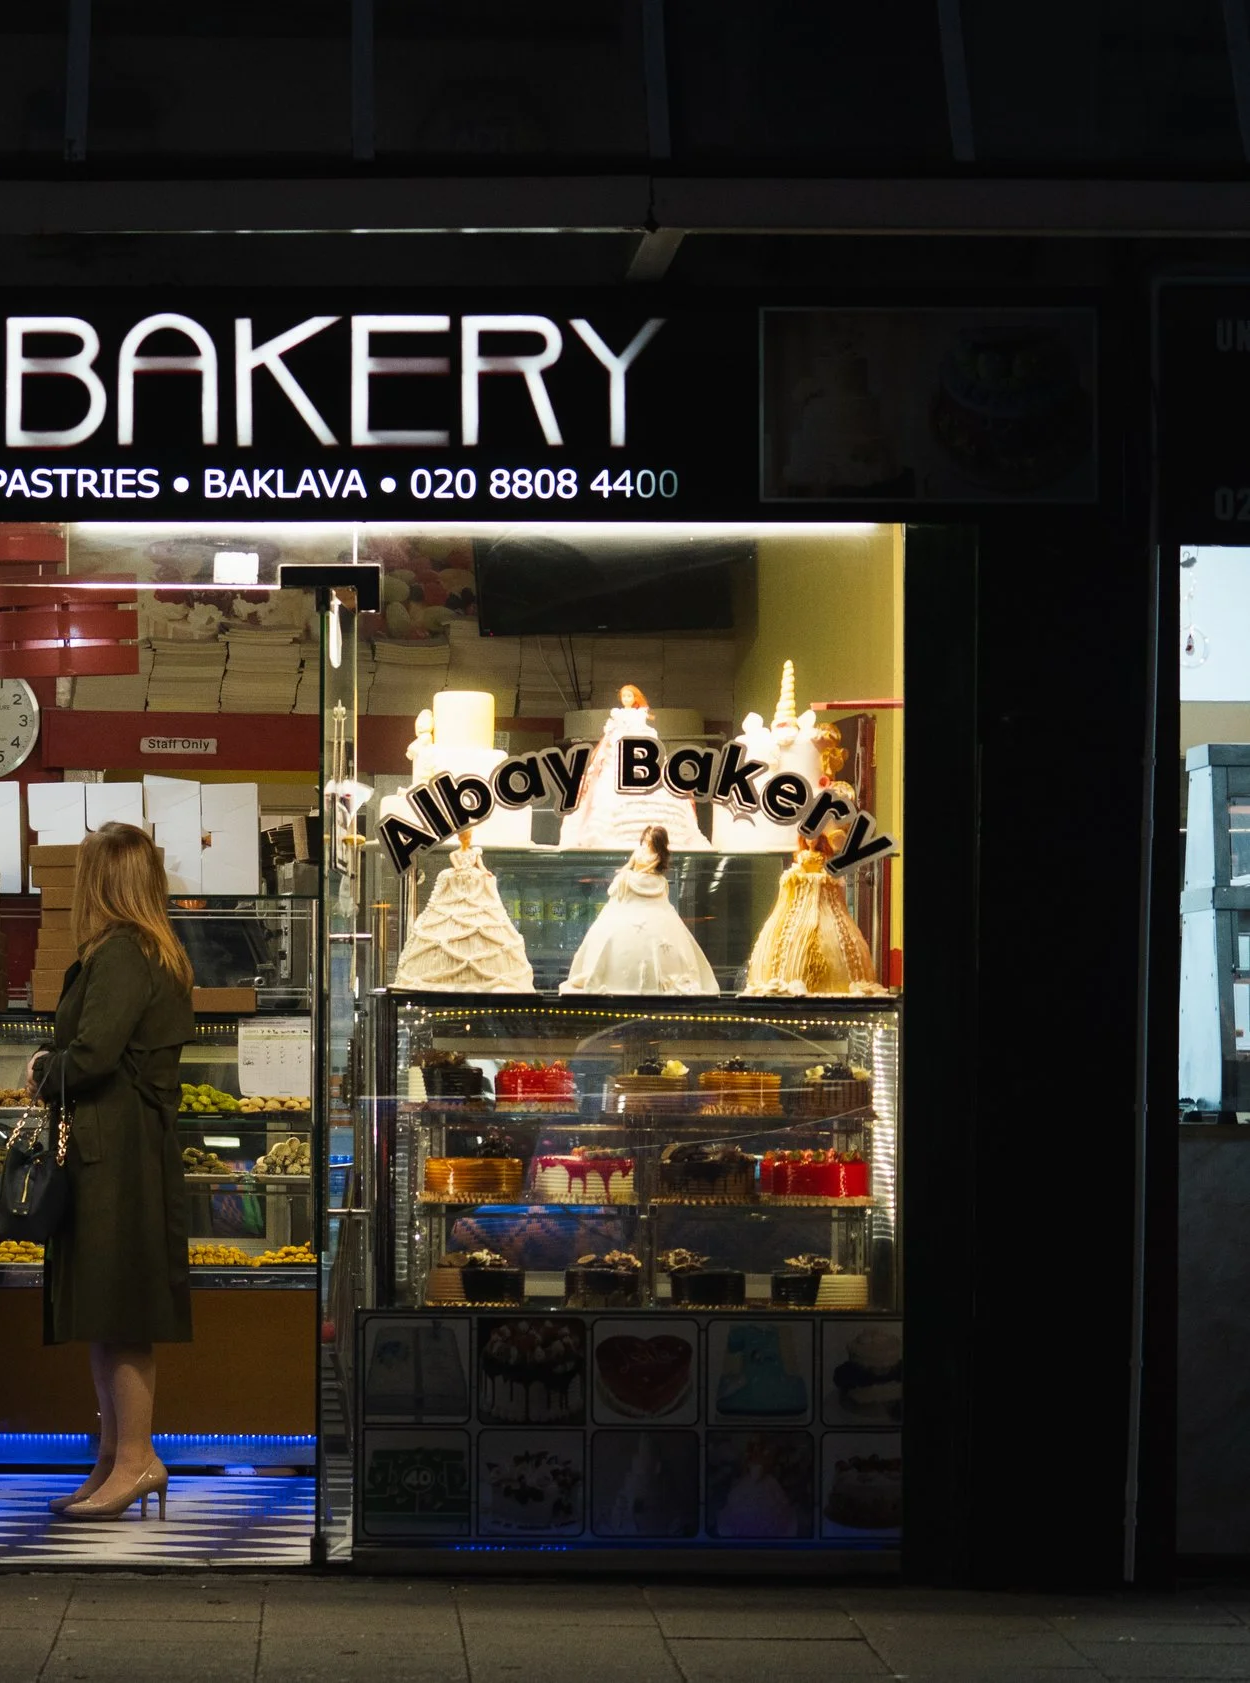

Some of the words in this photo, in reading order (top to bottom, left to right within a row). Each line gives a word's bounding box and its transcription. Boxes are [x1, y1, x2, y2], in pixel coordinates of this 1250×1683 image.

[5, 312, 667, 448] BAKERY
[203, 467, 368, 499] BAKLAVA
[410, 467, 478, 500] 020
[489, 467, 579, 500] 8808
[589, 468, 679, 500] 4400
[12, 693, 23, 706] 2
[18, 714, 29, 727] 3
[10, 735, 21, 748] 4
[147, 738, 177, 749] Staff
[181, 739, 210, 752] Only
[379, 744, 592, 875] Albay
[616, 737, 896, 875] Bakery
[405, 1470, 431, 1487] 40
